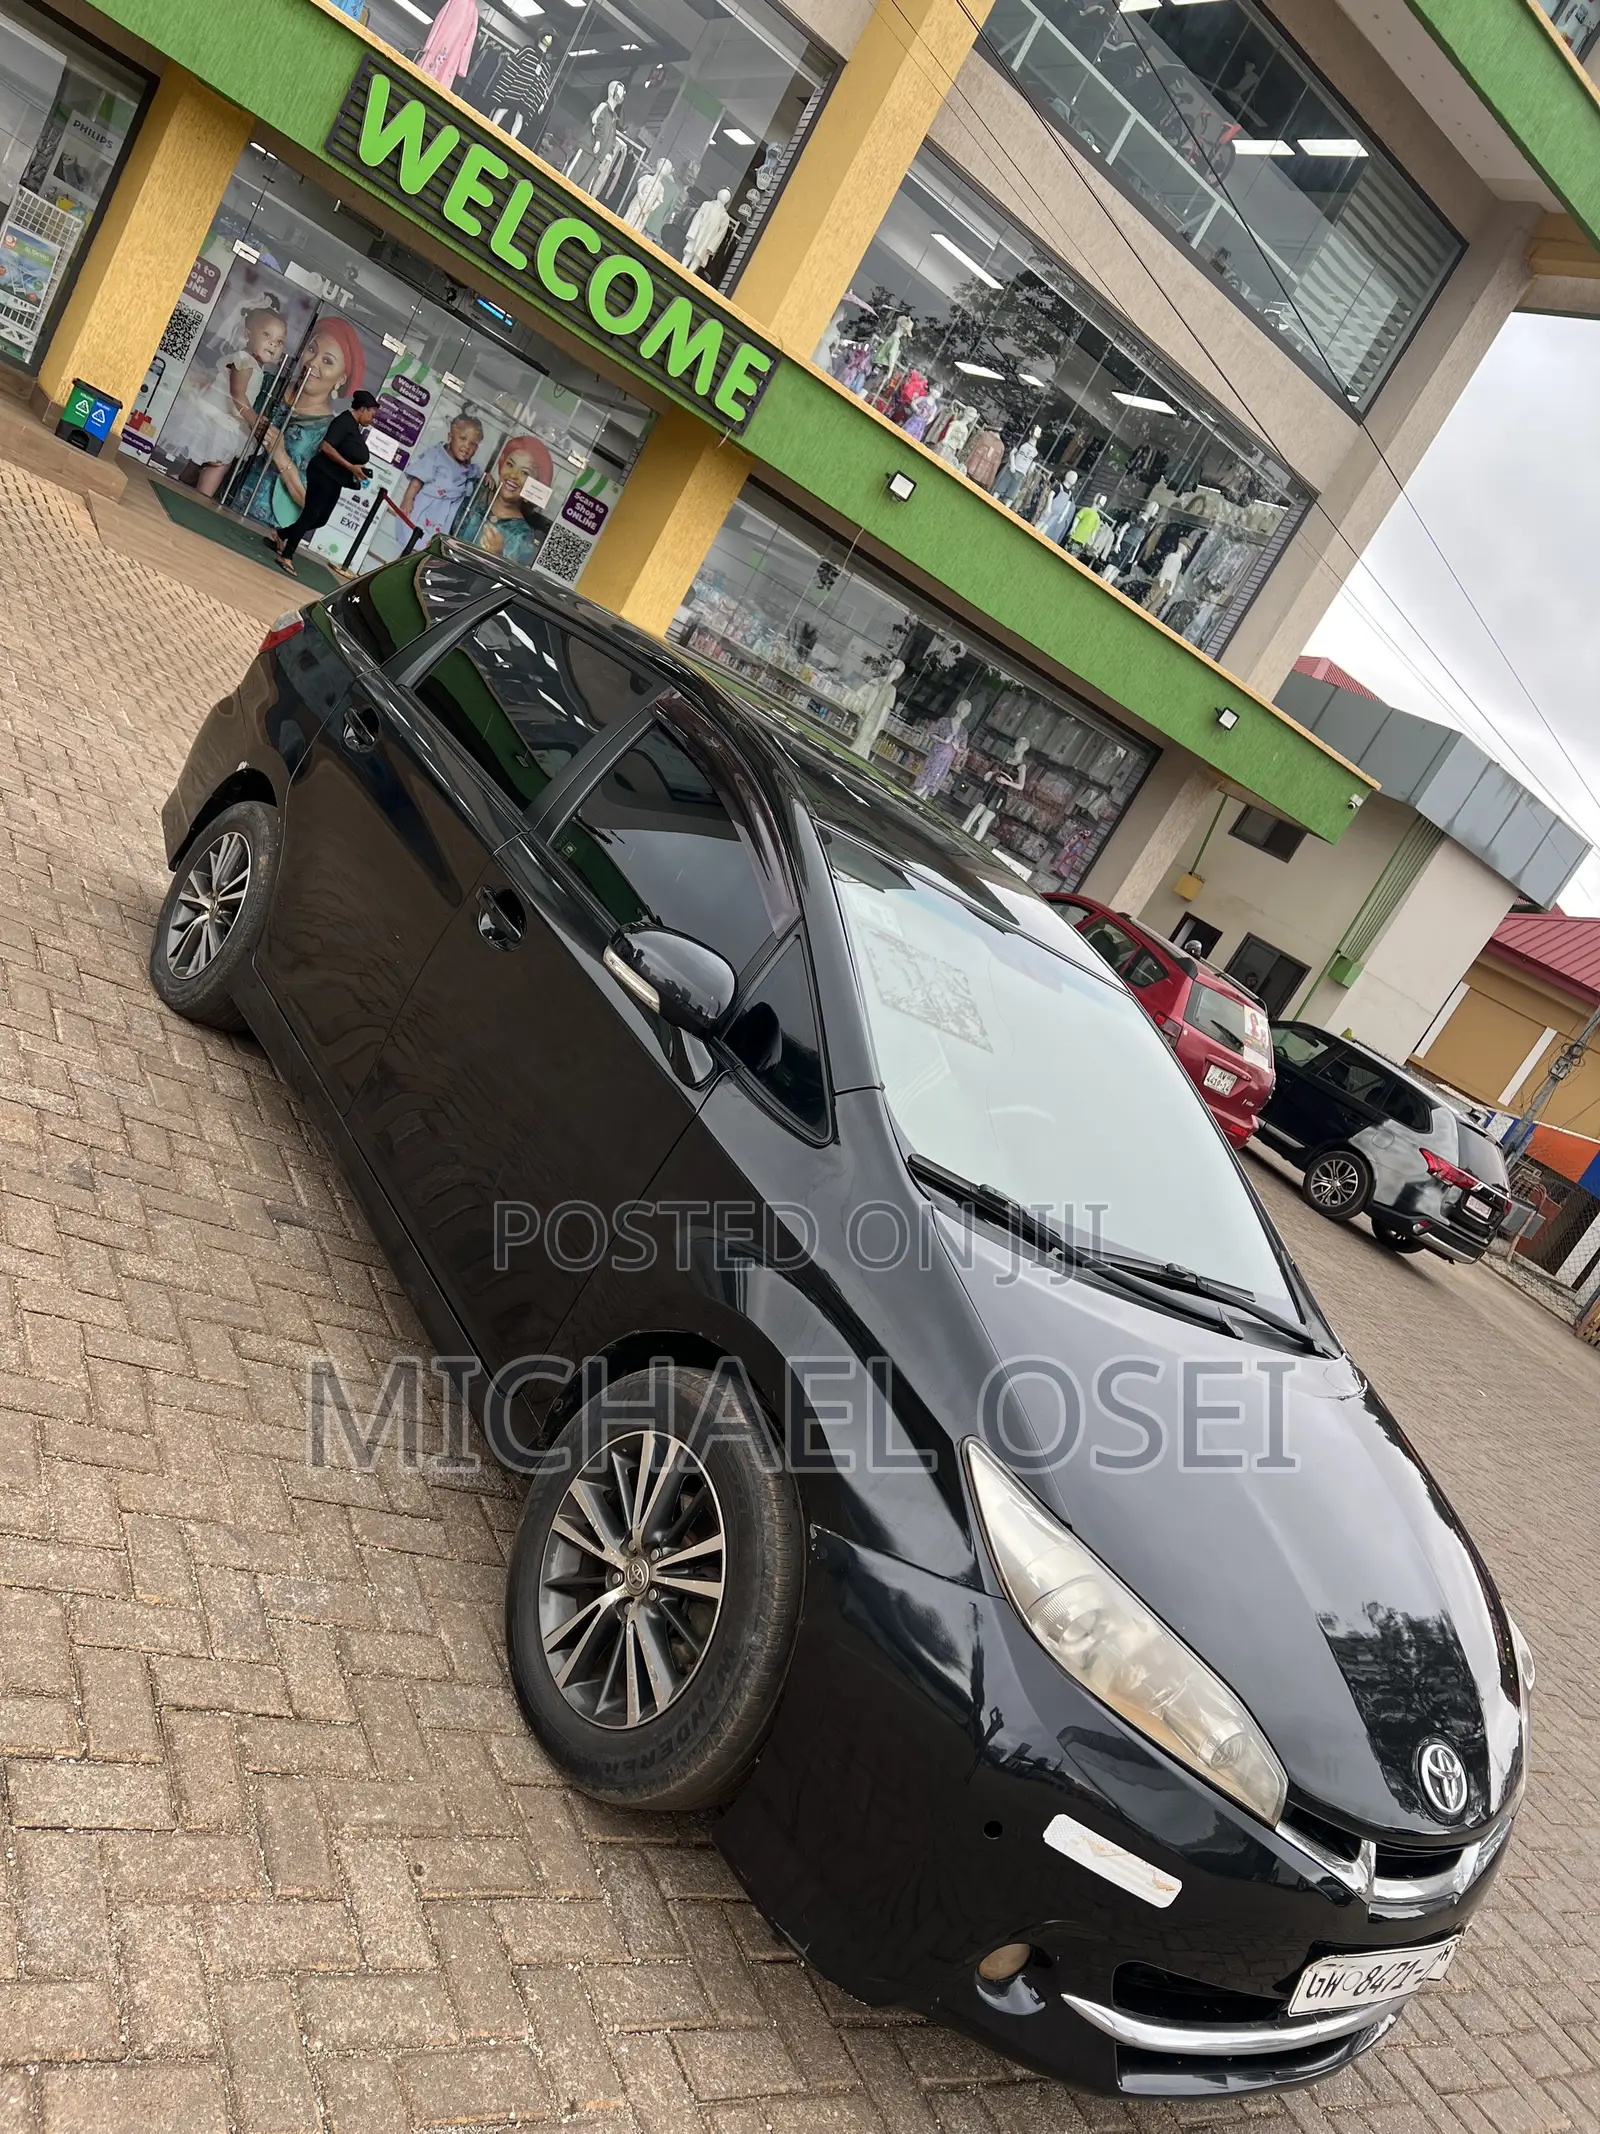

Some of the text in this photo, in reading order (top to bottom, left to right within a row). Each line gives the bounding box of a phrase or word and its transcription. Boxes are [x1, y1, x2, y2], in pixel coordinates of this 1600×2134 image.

[72, 119, 114, 149] PHILIPS
[358, 73, 771, 422] WELCOME
[189, 271, 206, 285] op
[203, 264, 216, 278] to
[185, 279, 209, 298] INE
[397, 376, 428, 400] Working
[399, 386, 421, 403] Hours
[379, 396, 399, 411] Monday
[401, 409, 424, 425] Saturday
[511, 402, 537, 427] IN
[385, 418, 404, 432] Sunday
[573, 491, 605, 514] Scan to
[574, 502, 597, 520] Shop
[340, 516, 360, 531] EXIT
[566, 508, 598, 531] ONLINE
[1305, 1970, 1346, 1999] GW
